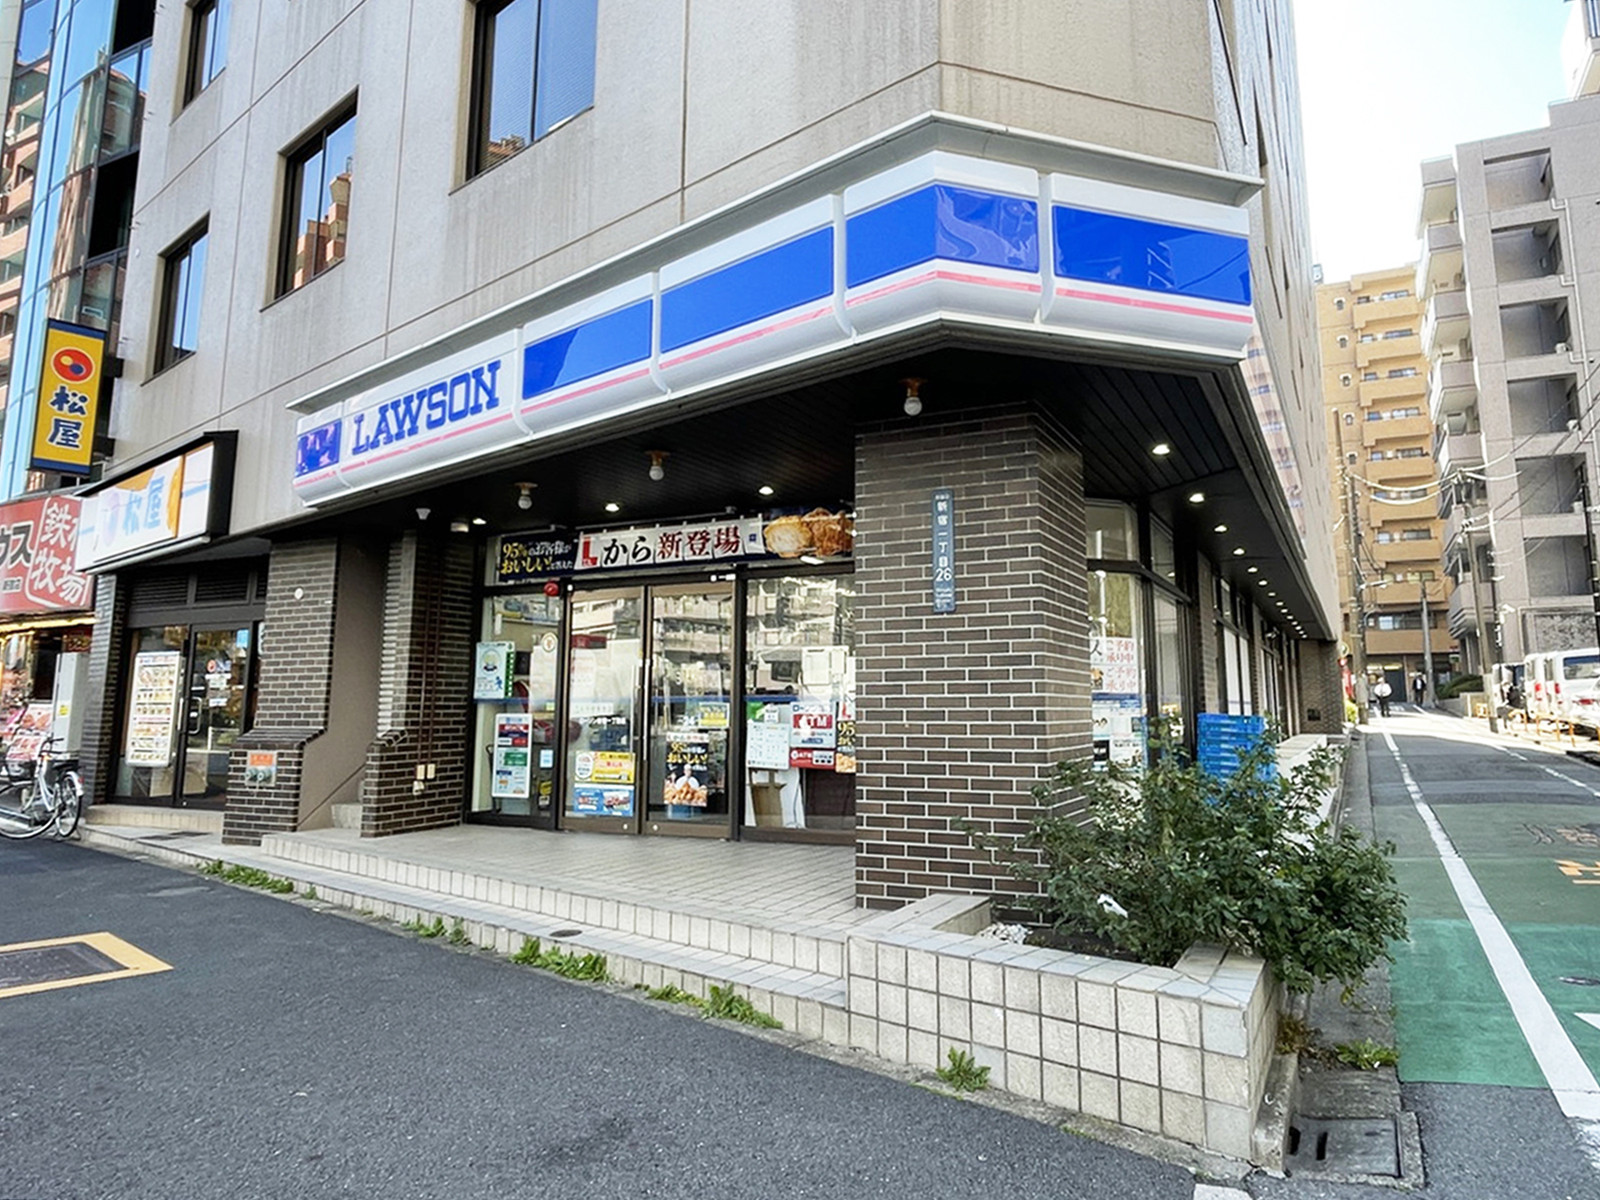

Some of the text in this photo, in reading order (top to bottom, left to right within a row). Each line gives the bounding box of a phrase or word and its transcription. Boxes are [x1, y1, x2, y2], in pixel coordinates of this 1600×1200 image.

[48, 385, 88, 449] 松屋
[352, 360, 501, 455] LAWSON
[31, 548, 85, 604] 牧場
[935, 568, 952, 582] 26
